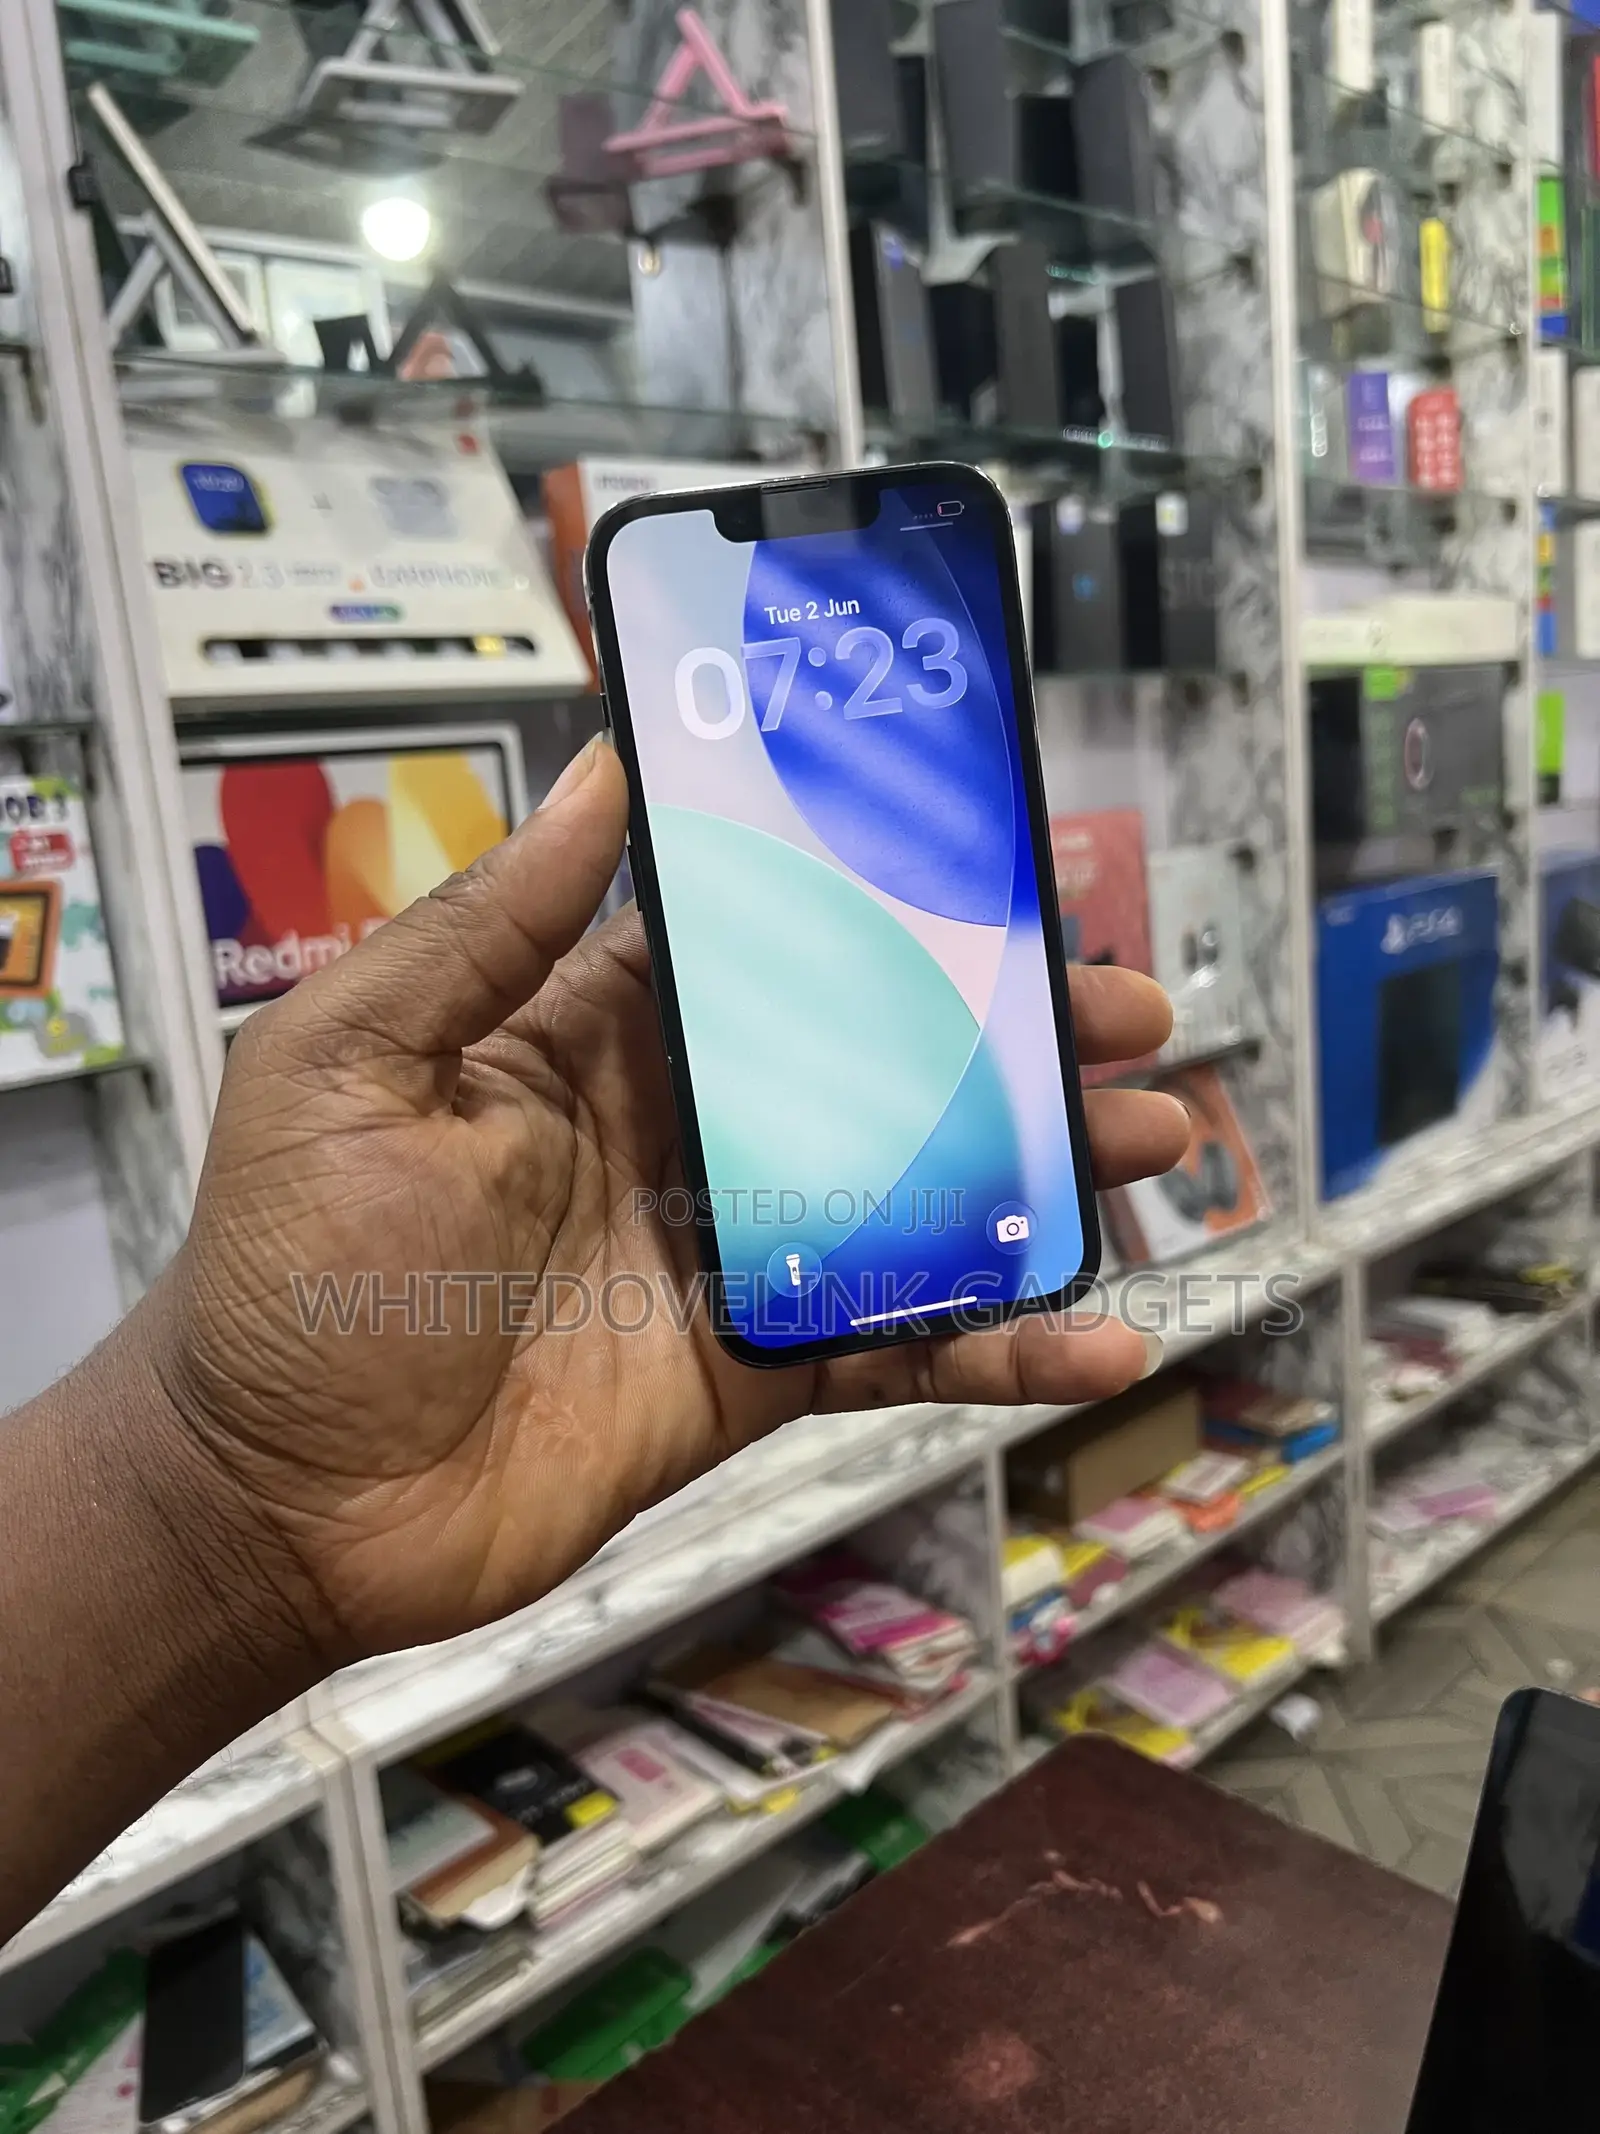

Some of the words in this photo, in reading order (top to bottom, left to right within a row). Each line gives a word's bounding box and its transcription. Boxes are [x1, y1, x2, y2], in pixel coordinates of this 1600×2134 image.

[763, 606, 801, 625] Tue
[805, 601, 820, 620] 2
[823, 598, 861, 618] Jun
[674, 617, 968, 740] 07:23
[213, 922, 351, 989] Redmi
